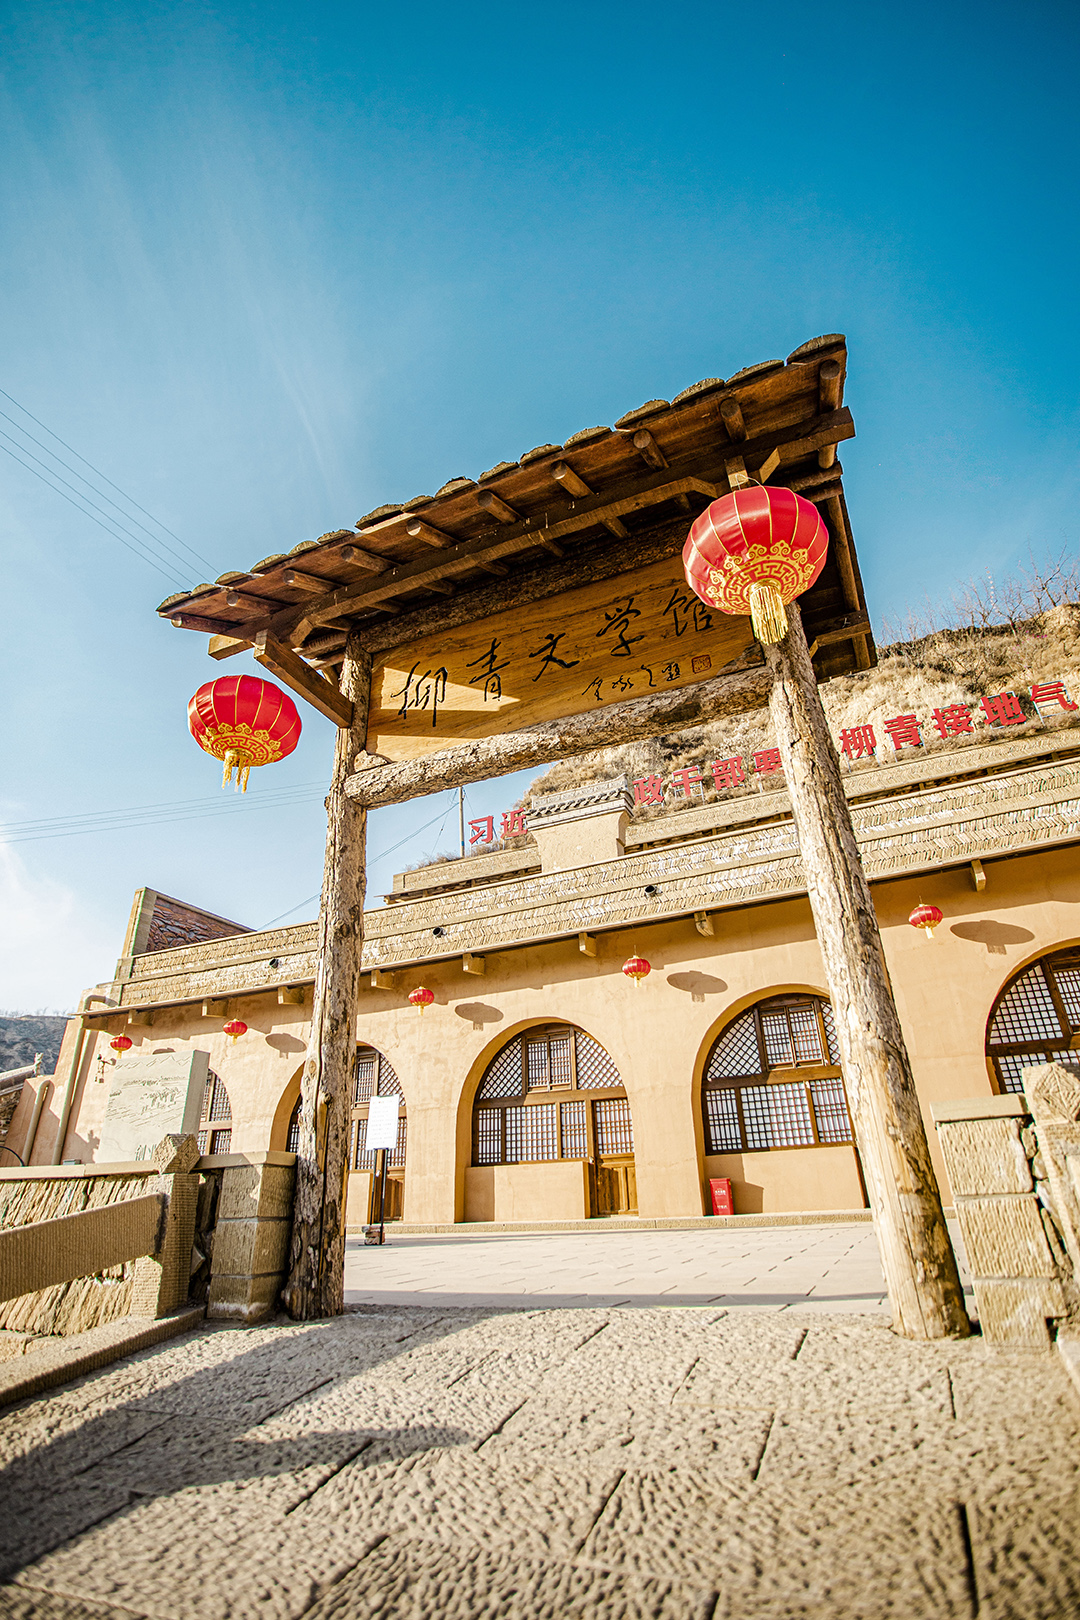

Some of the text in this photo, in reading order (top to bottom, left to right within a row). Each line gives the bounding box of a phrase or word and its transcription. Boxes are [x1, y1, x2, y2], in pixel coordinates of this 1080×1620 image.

[391, 588, 713, 727] 柳青文学馆
[838, 681, 1078, 759] 柳青接地气
